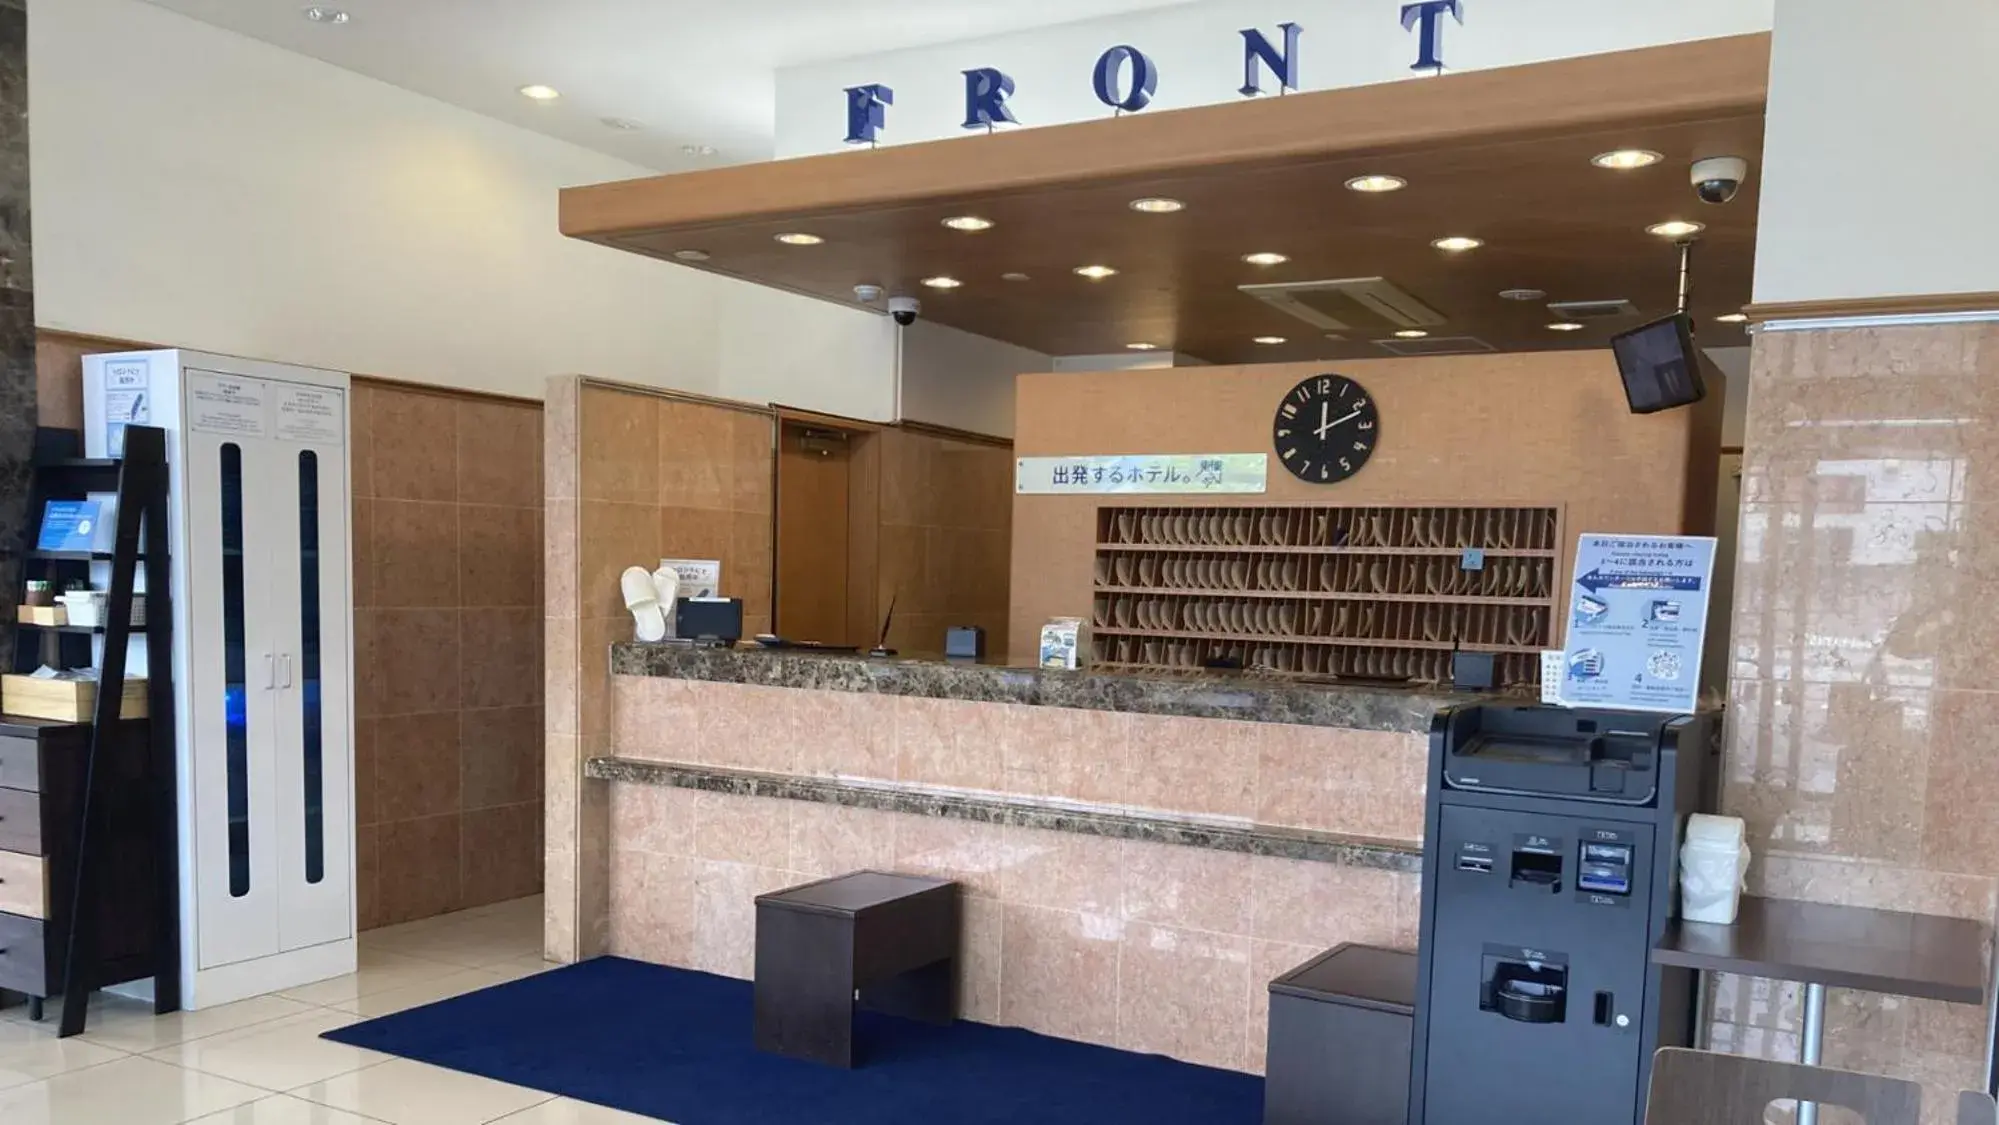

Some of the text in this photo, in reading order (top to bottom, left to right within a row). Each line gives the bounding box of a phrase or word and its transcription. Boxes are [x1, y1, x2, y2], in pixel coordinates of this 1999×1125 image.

[843, 0, 1463, 144] FRONT
[1297, 386, 1311, 402] 11
[1317, 379, 1330, 395] 12
[1339, 383, 1349, 397] 1
[1352, 398, 1366, 411] 2
[1358, 421, 1373, 430] 3
[1300, 460, 1311, 475] 7
[1321, 464, 1328, 479] 6
[1339, 457, 1351, 471] 5
[1052, 464, 1191, 485] 出発するホテル。
